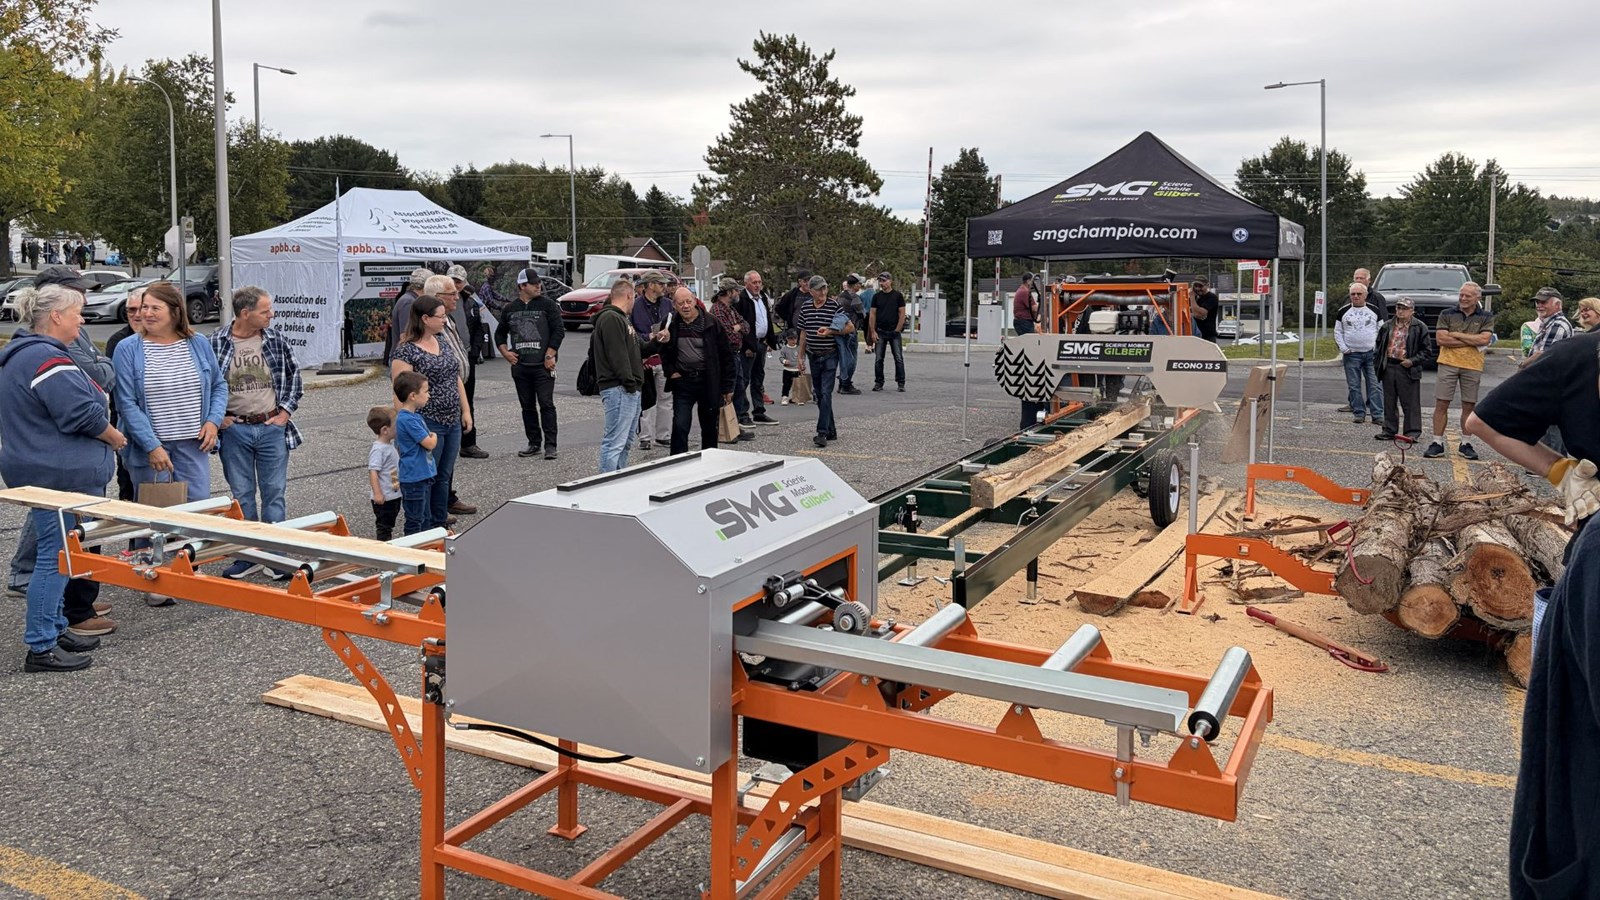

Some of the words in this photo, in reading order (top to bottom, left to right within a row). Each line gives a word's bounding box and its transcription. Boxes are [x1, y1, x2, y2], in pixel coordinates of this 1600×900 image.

[1060, 181, 1153, 199] SMG
[1032, 223, 1198, 243] smgchampion.com
[270, 242, 301, 255] apbb.ca
[346, 243, 387, 255] apbb.ca
[403, 246, 449, 254] ENSEMBLE
[469, 246, 483, 254] UNE
[483, 245, 503, 253] FORÊT
[503, 245, 530, 253] D'AVENIR
[273, 293, 314, 305] Association
[315, 294, 327, 305] des
[273, 308, 320, 320] propriétaires
[274, 322, 283, 332] de
[284, 322, 305, 333] boisés
[306, 323, 315, 333] de
[1062, 342, 1101, 355] SMG
[1104, 347, 1150, 356] GILBERT
[1205, 362, 1213, 370] 13
[781, 474, 806, 488] Scierie
[790, 483, 817, 497] Mobile
[799, 489, 835, 509] Gilbert
[705, 482, 798, 540] SMG
